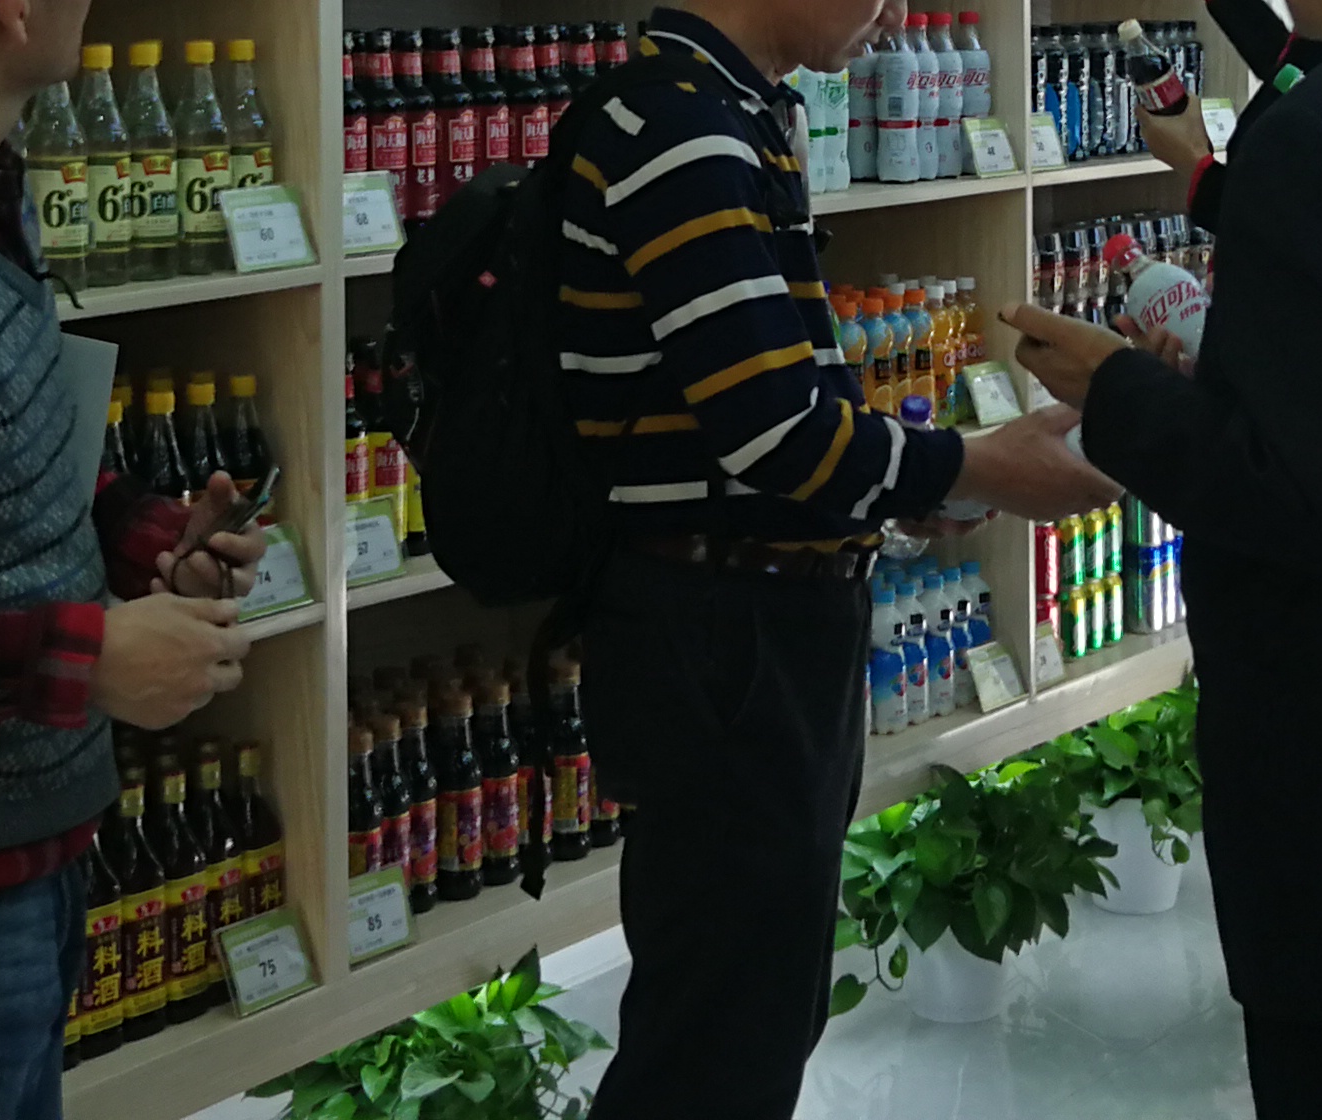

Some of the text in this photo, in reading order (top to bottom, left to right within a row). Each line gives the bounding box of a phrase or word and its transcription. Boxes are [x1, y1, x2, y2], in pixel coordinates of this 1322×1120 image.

[136, 925, 165, 990] 料酒
[179, 909, 208, 973] 料酒
[258, 958, 277, 978] 75
[92, 941, 122, 1007] 料酒
